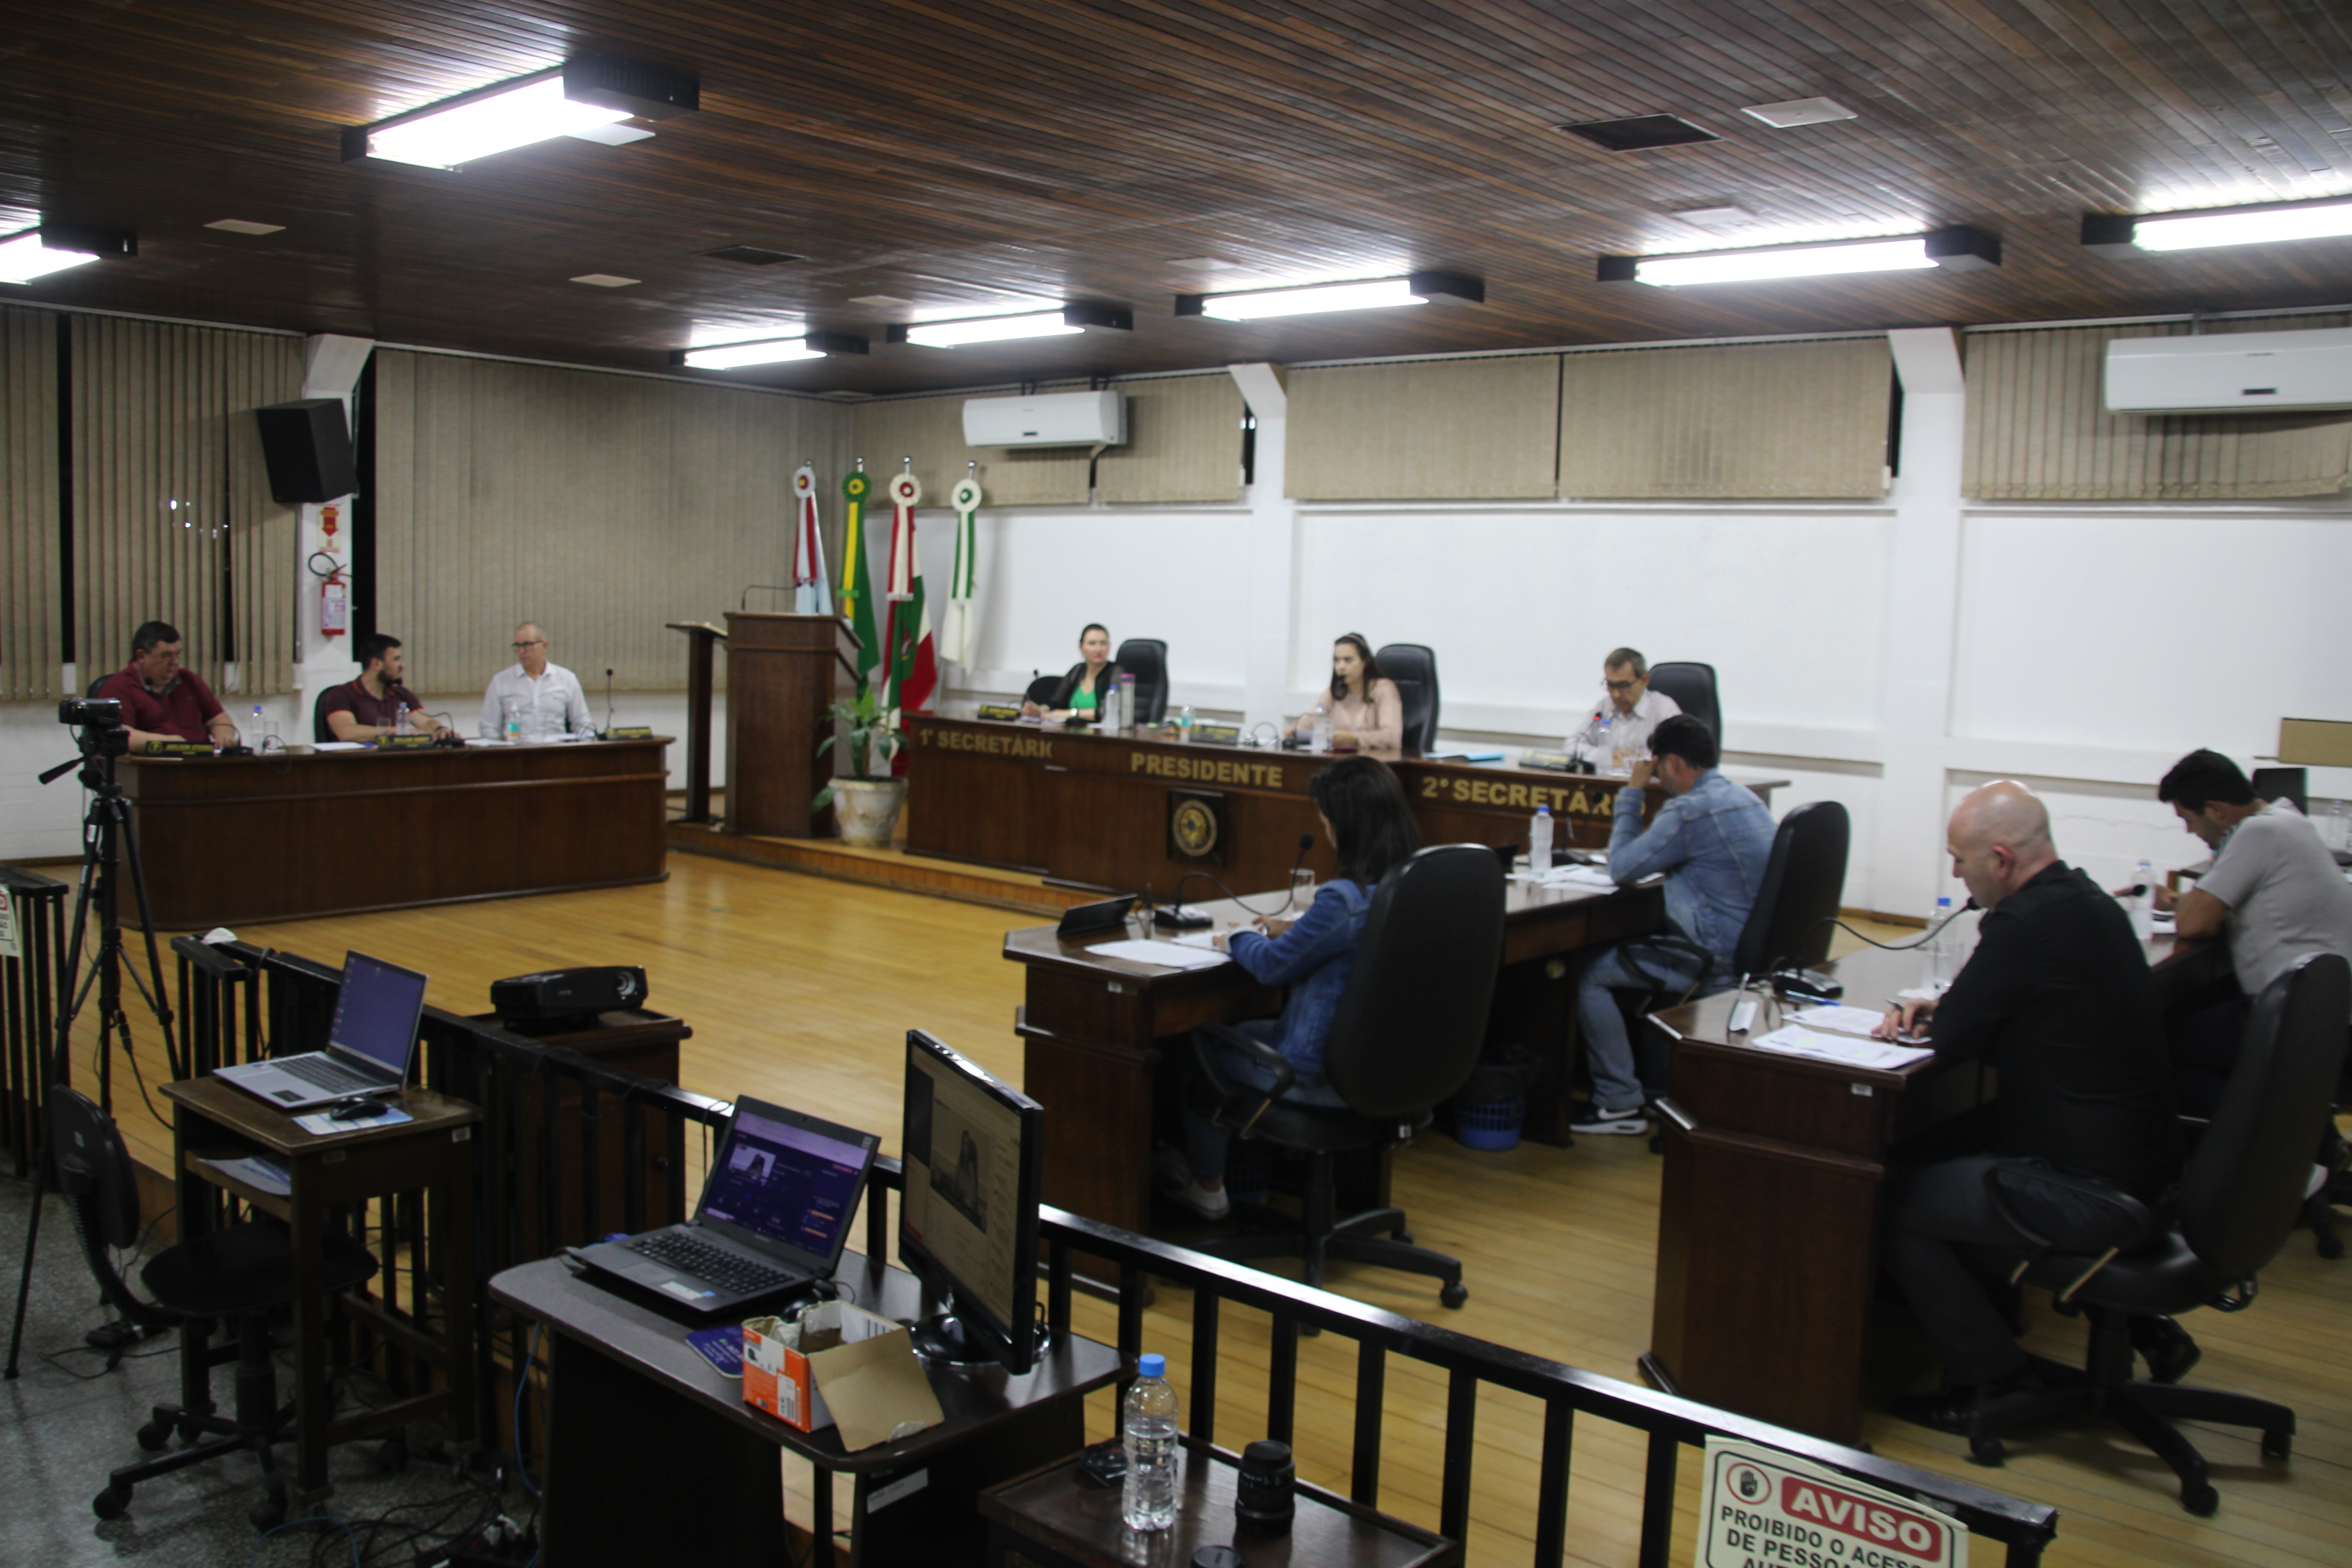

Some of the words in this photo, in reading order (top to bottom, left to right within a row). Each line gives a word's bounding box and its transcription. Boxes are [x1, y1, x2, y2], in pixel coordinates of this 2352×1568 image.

[1131, 752, 1283, 788] PRESIDENTE
[1721, 1505, 1822, 1548] PROIBIDO
[1830, 1539, 1845, 1555] O
[1791, 1487, 1932, 1551] AVISO
[1727, 1528, 1756, 1553] DE
[1763, 1539, 1851, 1568] PESSO
